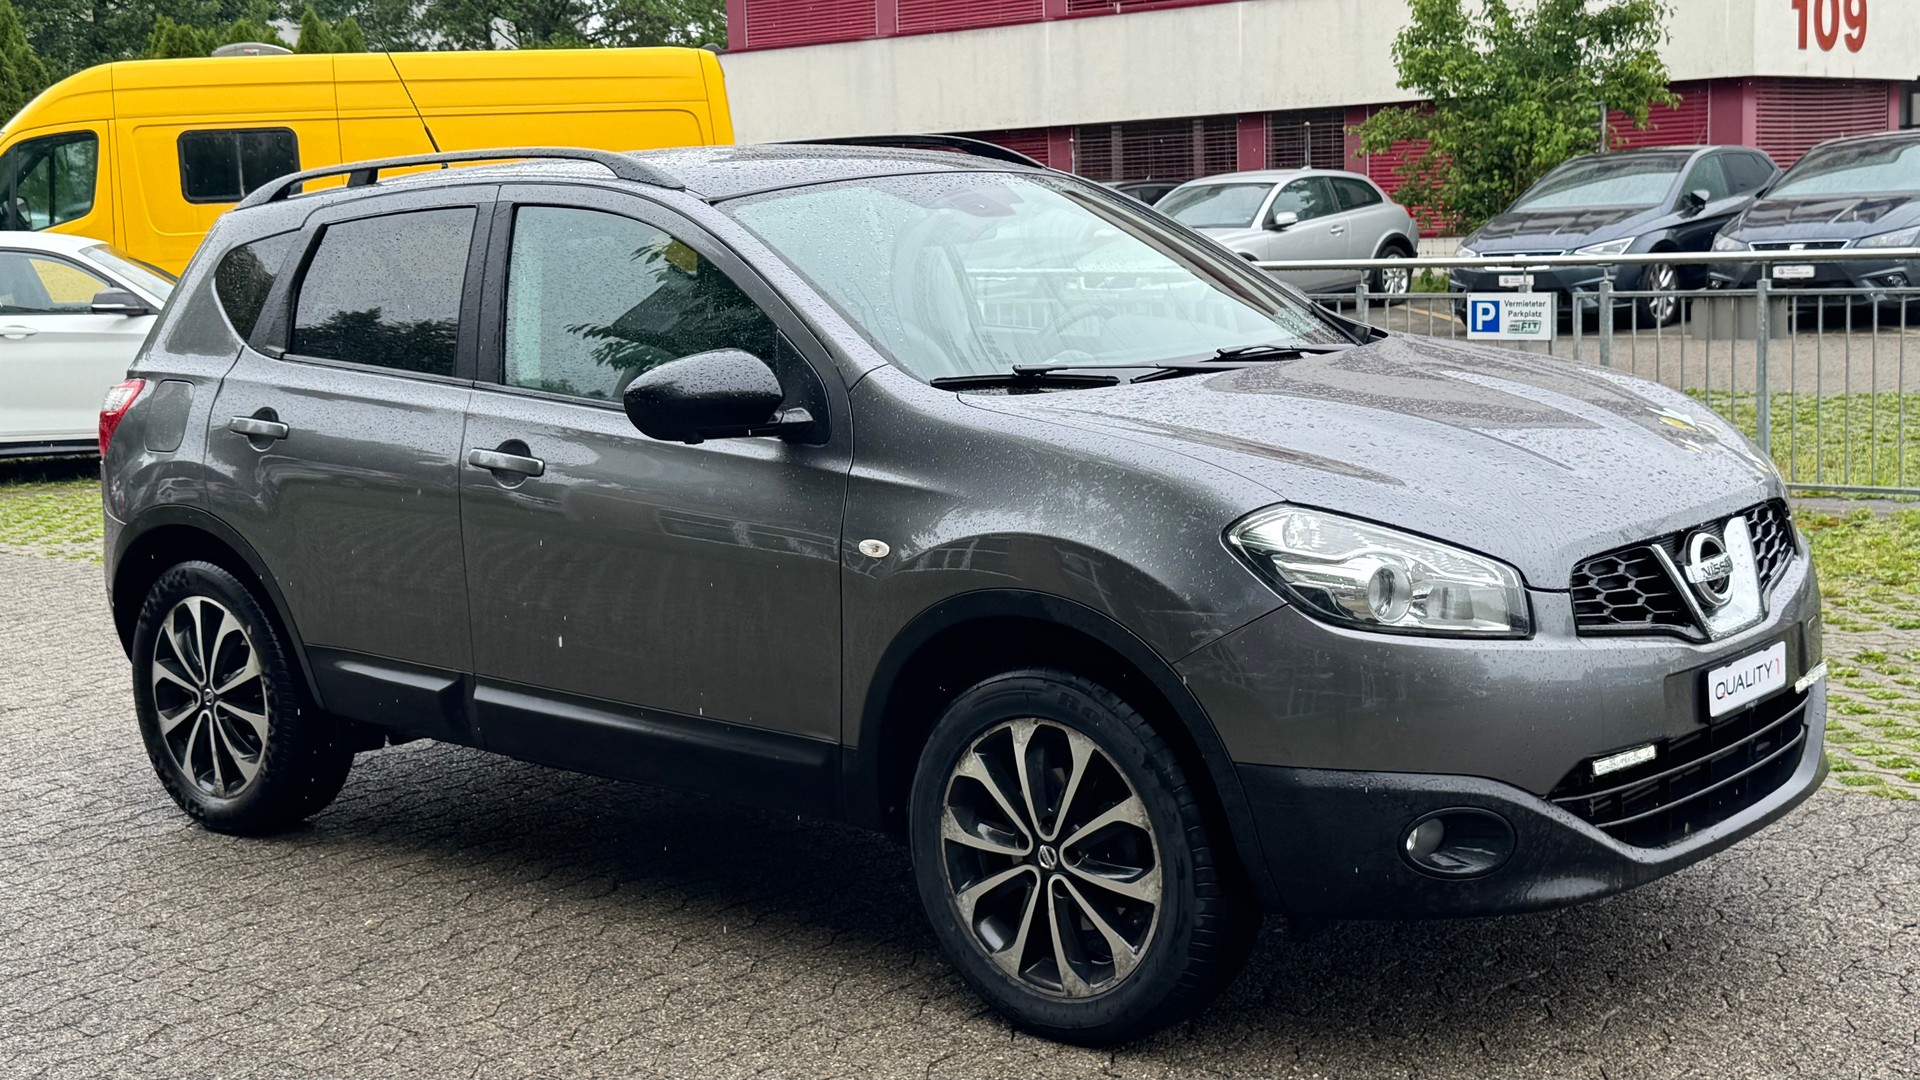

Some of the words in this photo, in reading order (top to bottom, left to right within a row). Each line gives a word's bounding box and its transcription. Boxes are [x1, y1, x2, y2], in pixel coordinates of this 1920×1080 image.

[1791, 0, 1867, 53] 109
[1503, 300, 1547, 308] Vermieteter
[1476, 302, 1496, 330] P
[1507, 310, 1543, 318] Parkplatz
[1521, 322, 1539, 331] FIT
[1715, 660, 1772, 700] QUALITY
